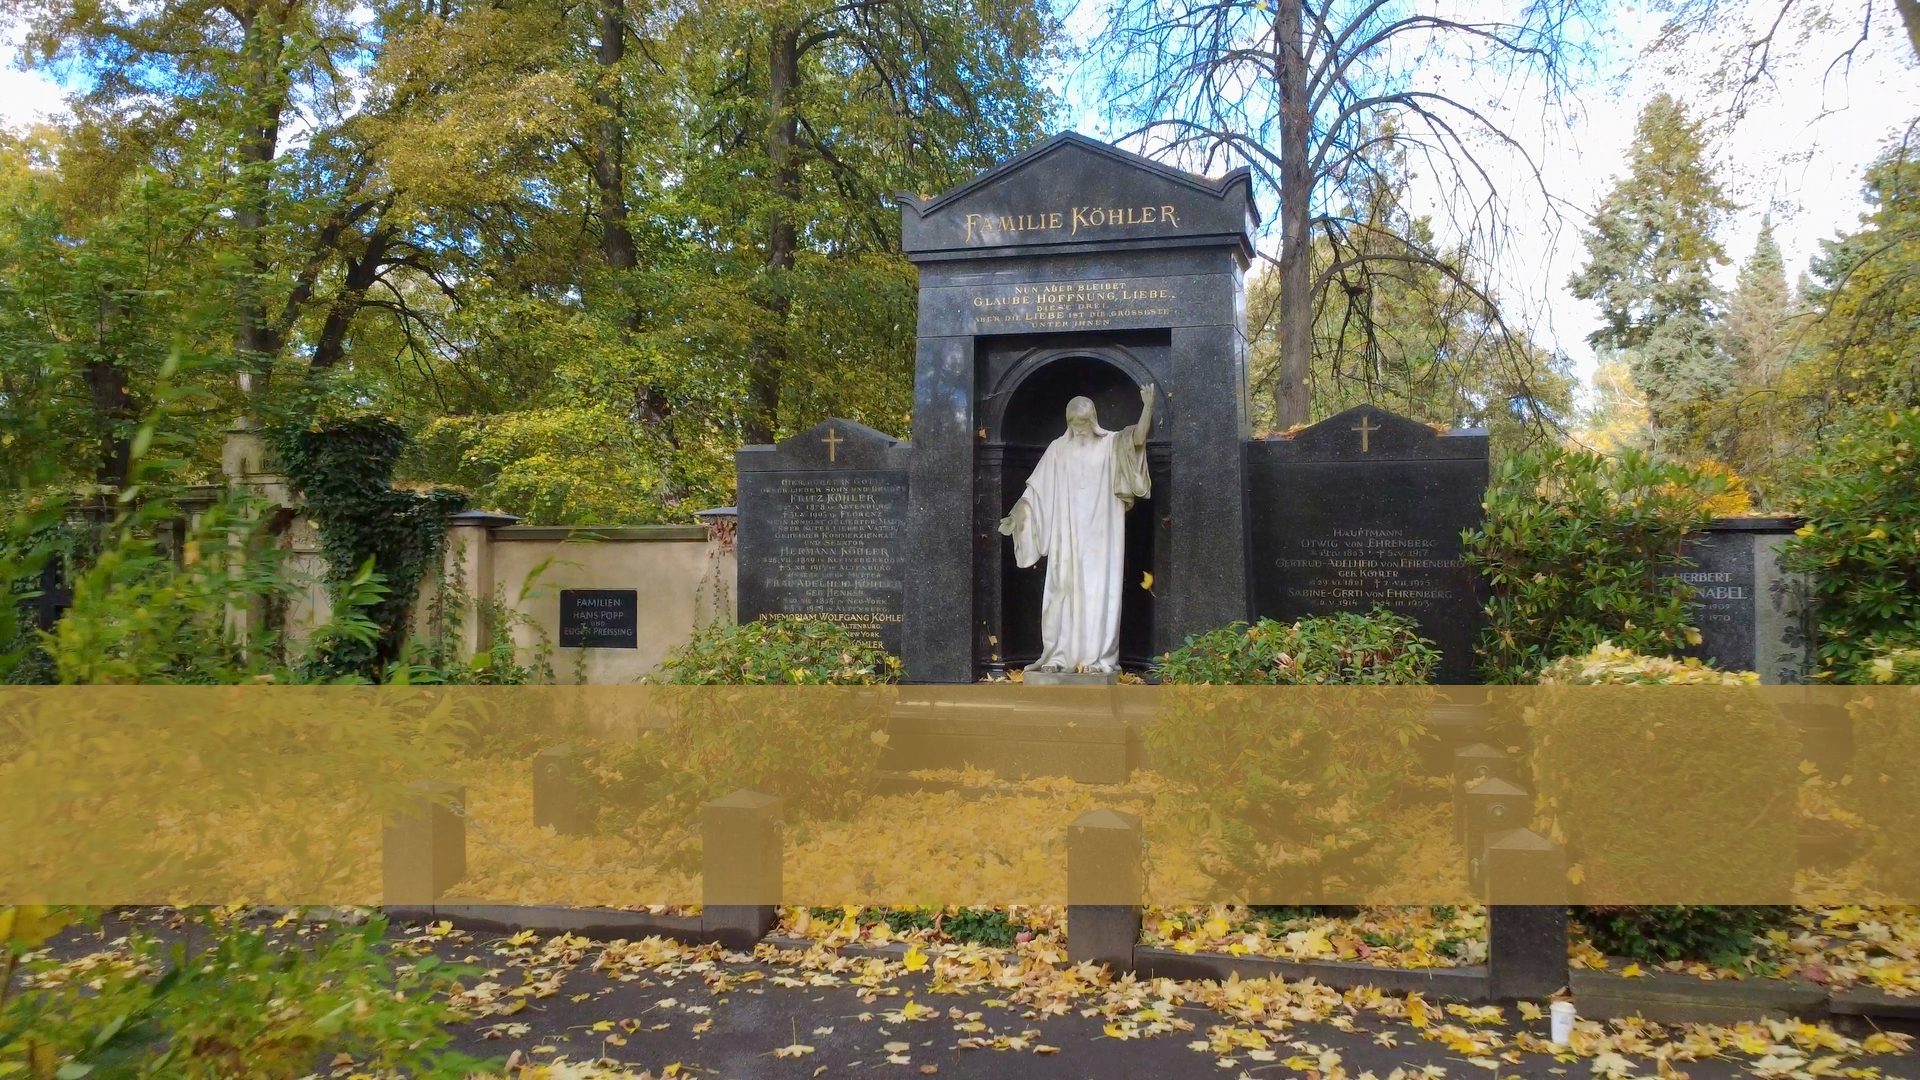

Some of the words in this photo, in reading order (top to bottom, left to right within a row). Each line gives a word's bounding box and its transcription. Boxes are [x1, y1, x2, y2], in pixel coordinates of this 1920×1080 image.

[966, 213, 1063, 244] FAMILIE
[1015, 286, 1038, 295] NUN
[1043, 284, 1073, 294] ABER
[1077, 282, 1126, 293] BLEIBET
[1036, 303, 1072, 313] DIESE
[976, 313, 1001, 323] ABER
[1005, 313, 1021, 322] DIE
[1025, 310, 1064, 321] LIEBE
[1068, 310, 1085, 320] IST
[1089, 309, 1106, 319] DIE
[1031, 319, 1069, 329] UNTER
[790, 486, 822, 494] LIEBER
[825, 486, 849, 494] SOHN
[790, 493, 825, 504] FRITZ
[826, 493, 876, 505] KÖHLER
[1333, 527, 1404, 538] HAUPTMANN
[1345, 541, 1364, 549] VON
[1366, 538, 1438, 549] EHRENBERG
[780, 546, 838, 558] HERMANN
[840, 545, 890, 557] KÖHLER
[1400, 558, 1465, 569] EHRENBERG
[1674, 572, 1733, 583] HERBERT
[1365, 591, 1385, 599] VON
[1386, 587, 1453, 600] EHRENBERG
[576, 598, 621, 608] FAMILIEN
[573, 610, 599, 620] HANS
[600, 610, 625, 620] POPP
[759, 613, 768, 621] IN
[769, 612, 817, 622] MEMORIAM
[818, 612, 870, 622] WOLFGANG
[593, 627, 633, 637] PREISSING
